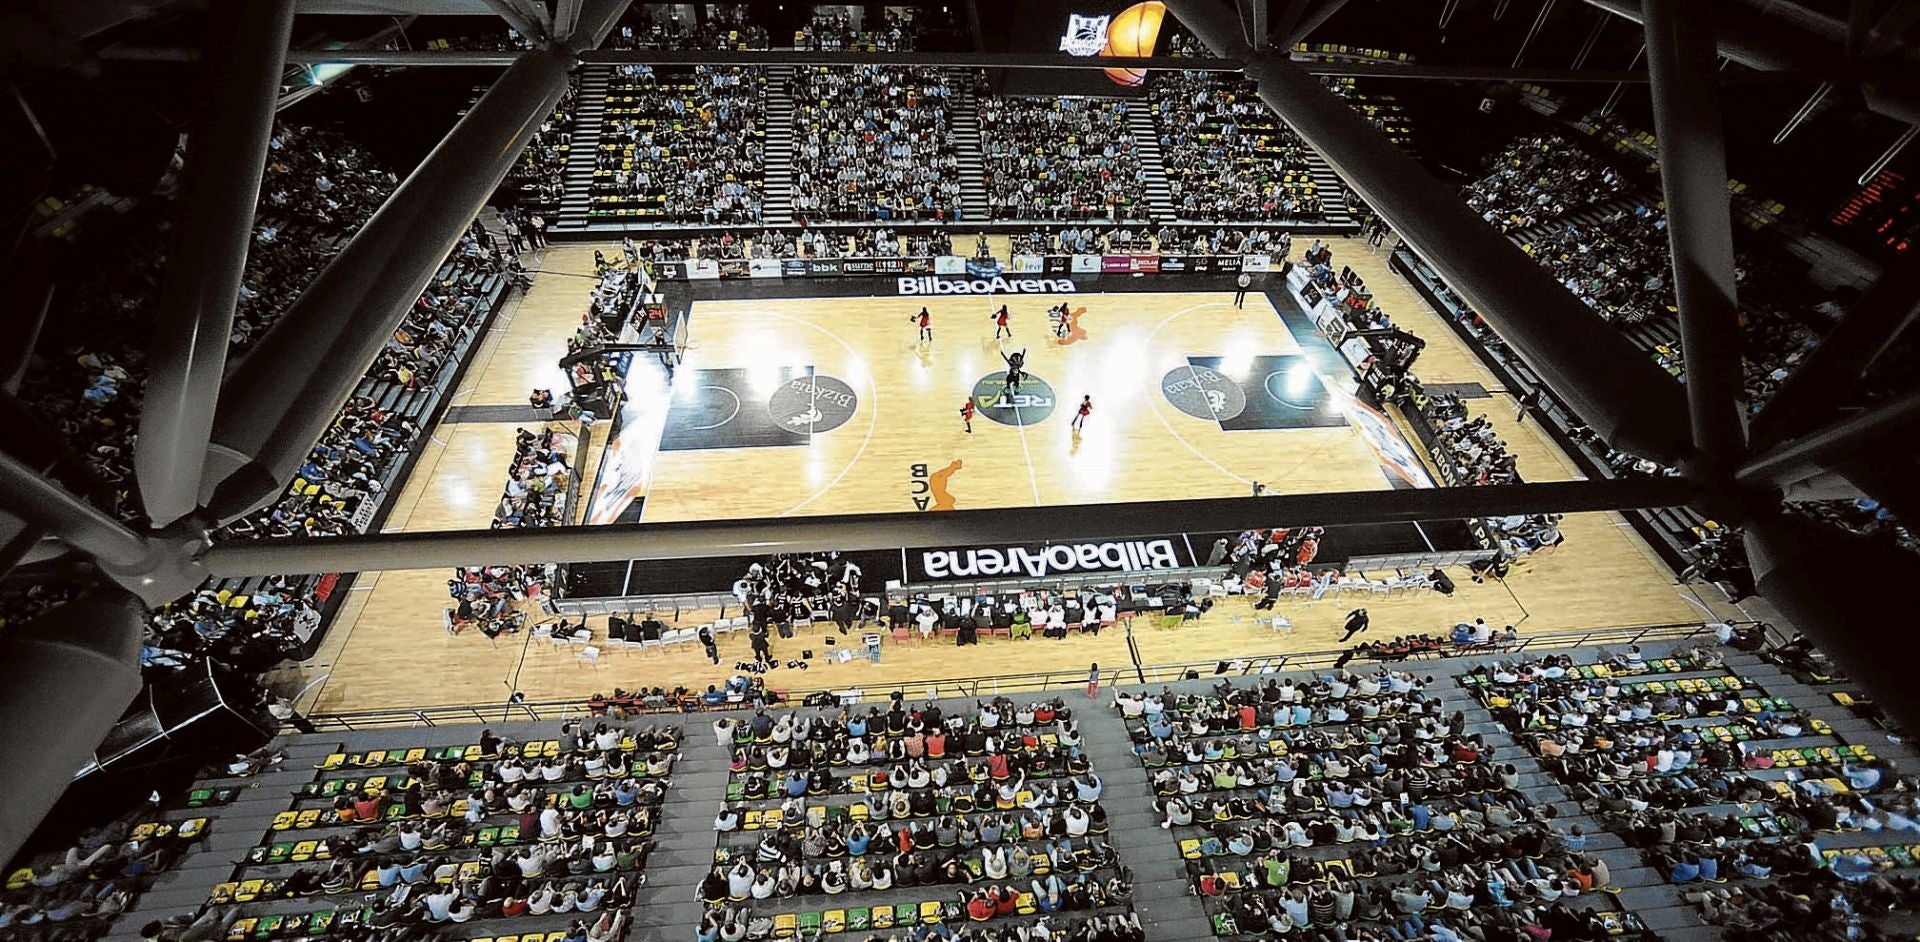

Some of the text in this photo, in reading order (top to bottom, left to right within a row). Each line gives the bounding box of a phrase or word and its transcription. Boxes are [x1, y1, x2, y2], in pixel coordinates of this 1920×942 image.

[812, 263, 838, 272] bbk
[897, 276, 1077, 295] BilbaoArena
[648, 309, 662, 319] 24
[790, 380, 855, 408] Bizkaia
[978, 390, 1052, 408] RETA
[910, 463, 931, 511] ACB
[922, 539, 1180, 578] BilbaoArena
